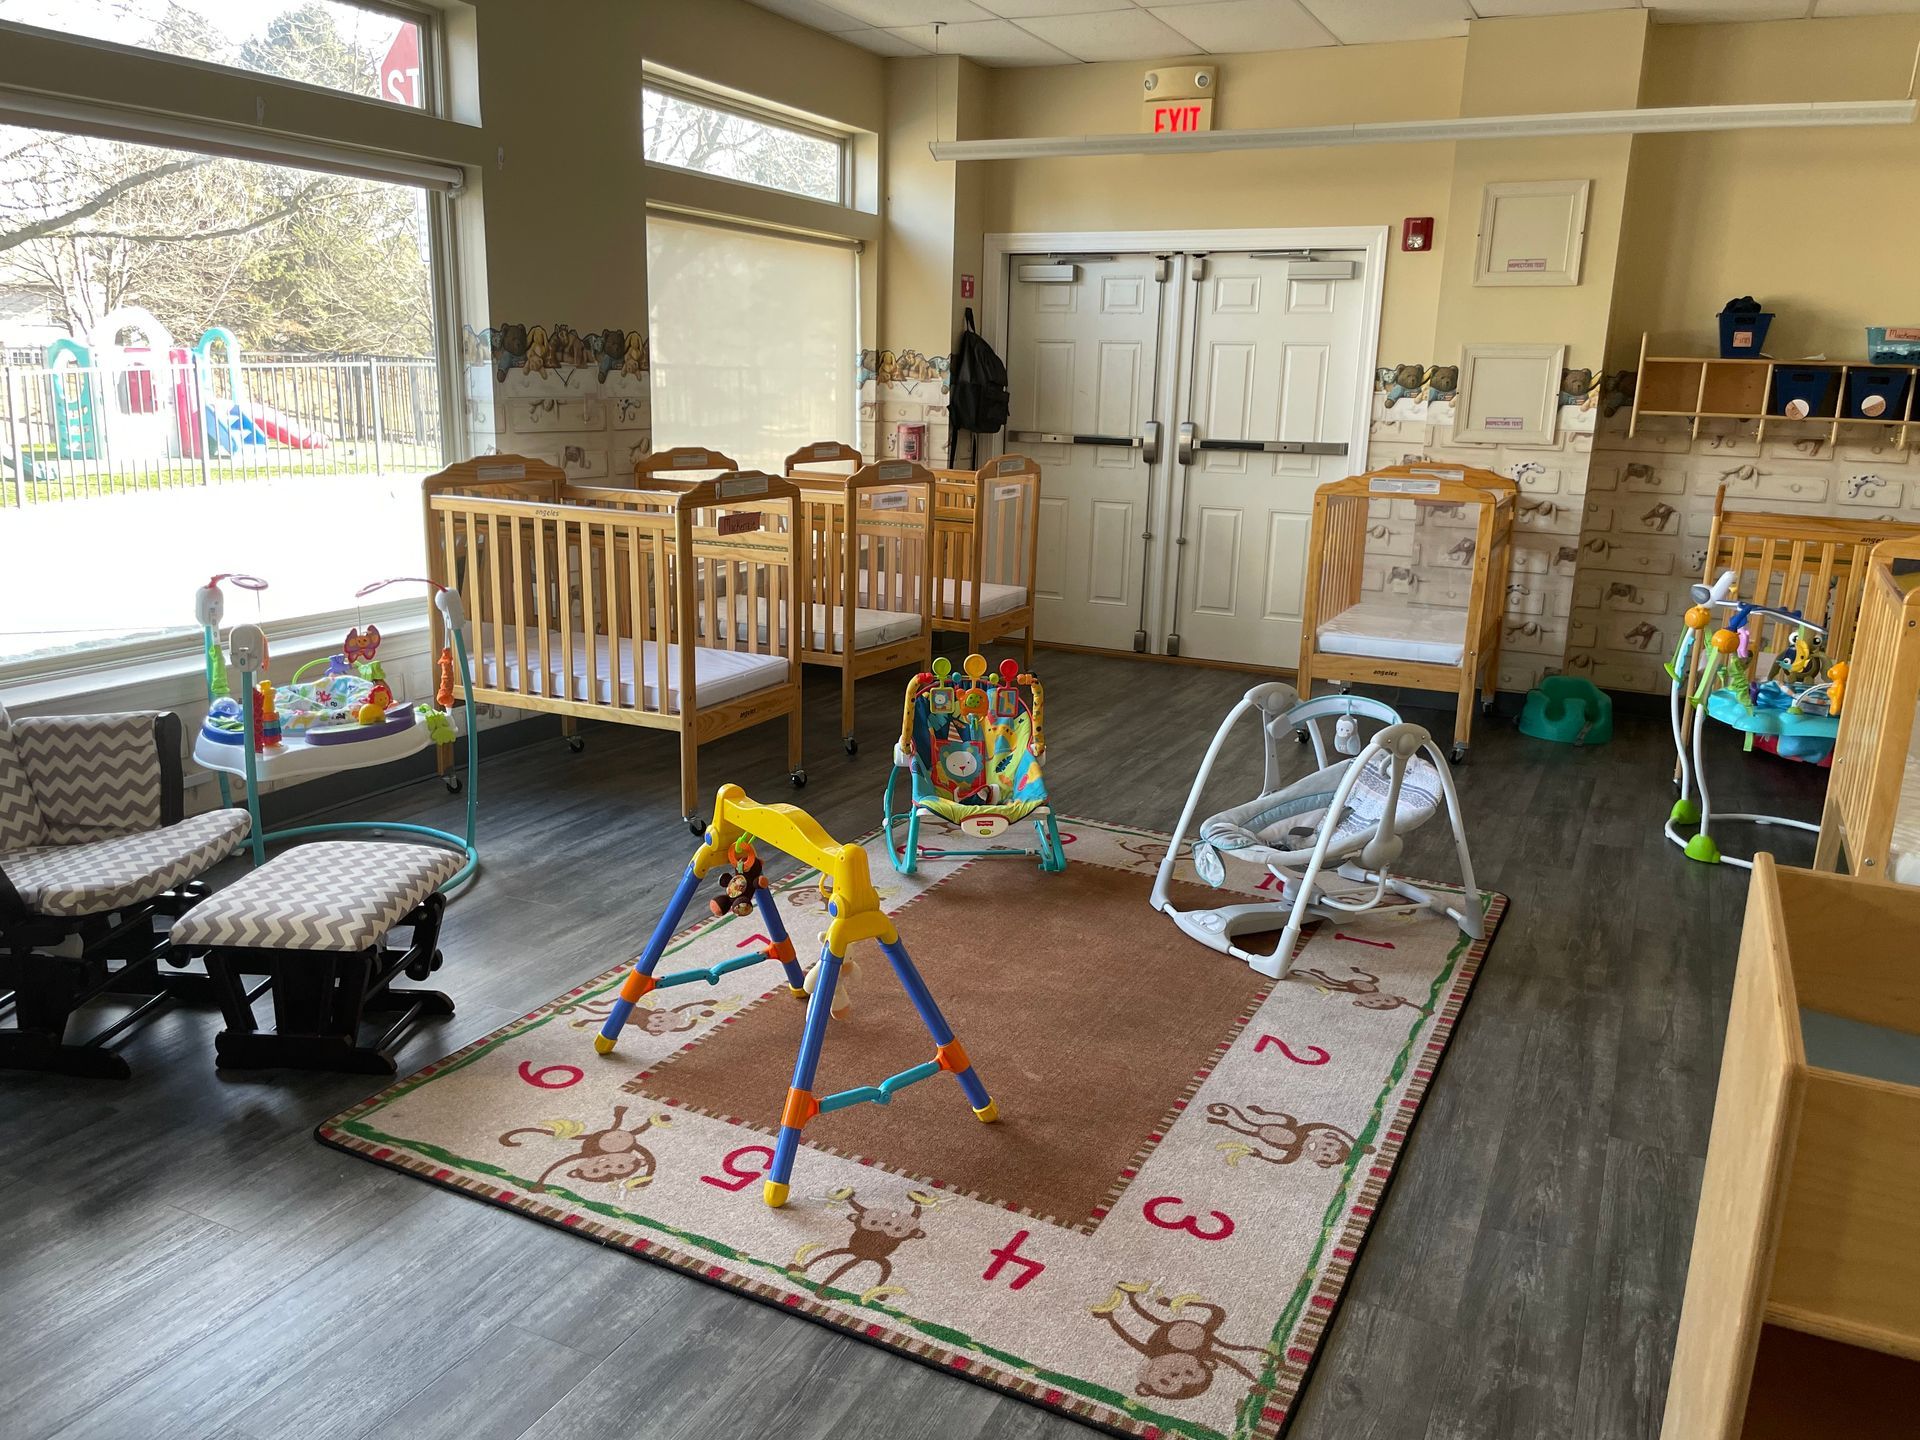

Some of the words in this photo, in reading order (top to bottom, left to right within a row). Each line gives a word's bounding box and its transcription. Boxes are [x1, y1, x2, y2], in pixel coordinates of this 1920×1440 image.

[1154, 105, 1202, 134] EXIT
[1254, 1034, 1331, 1066] 2
[700, 1145, 776, 1192] 5
[1142, 1196, 1235, 1241] 3
[982, 1230, 1046, 1291] 4
